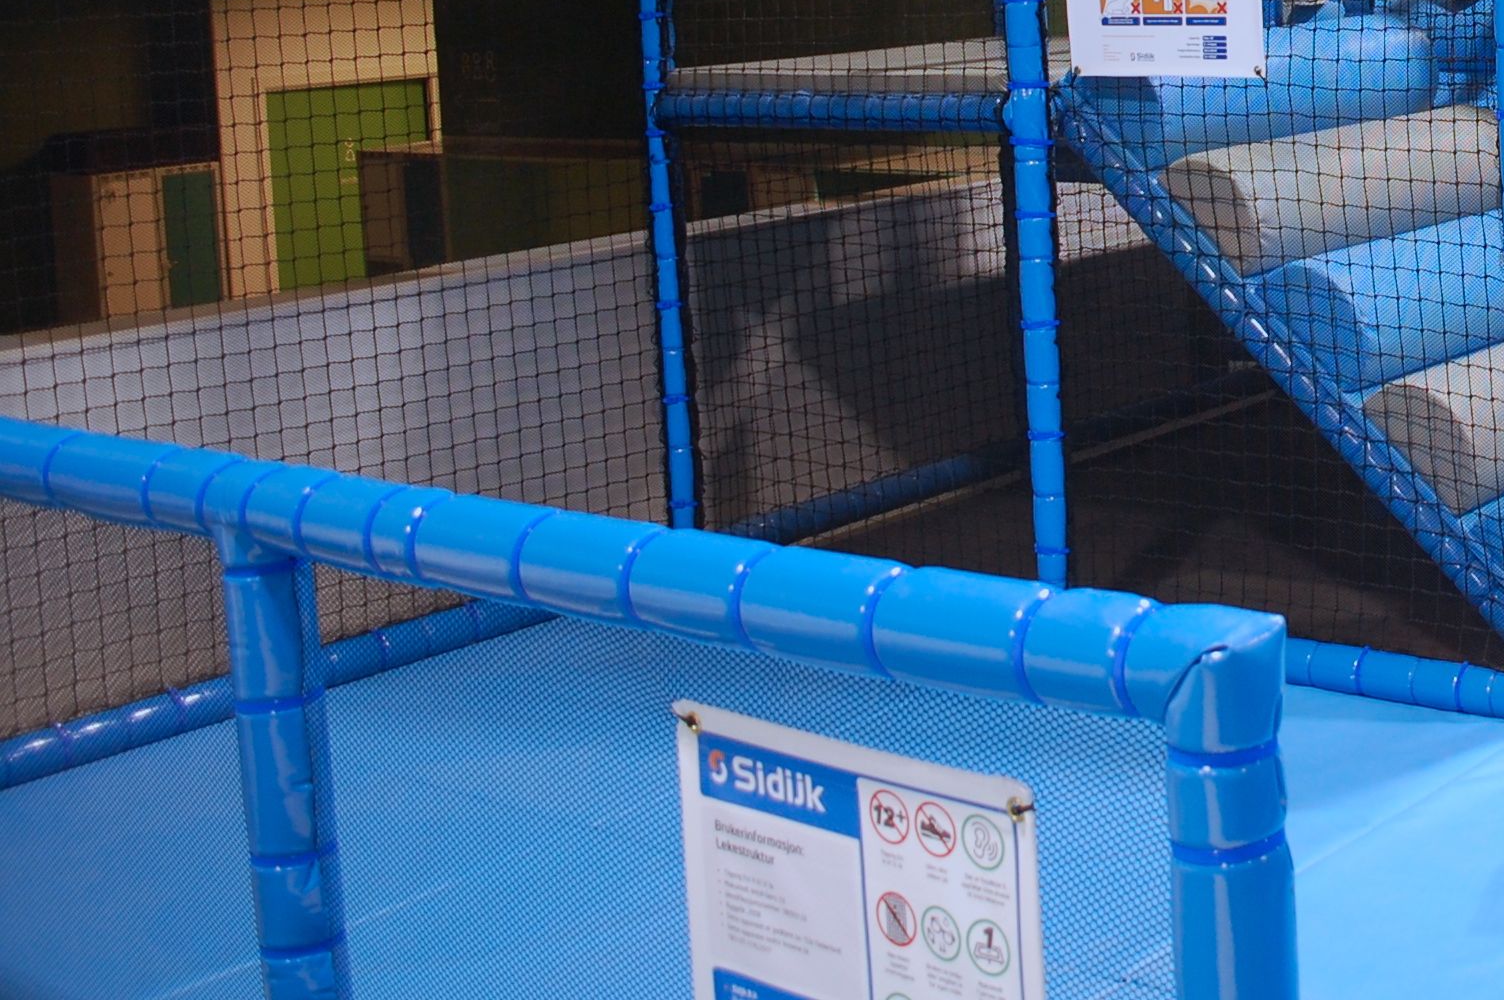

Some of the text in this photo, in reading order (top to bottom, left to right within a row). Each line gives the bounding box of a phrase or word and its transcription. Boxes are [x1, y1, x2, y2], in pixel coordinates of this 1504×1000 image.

[732, 756, 826, 813] Sidijk
[714, 819, 804, 856] Brukerinformasjon:
[716, 839, 775, 865] Lekestruktur
